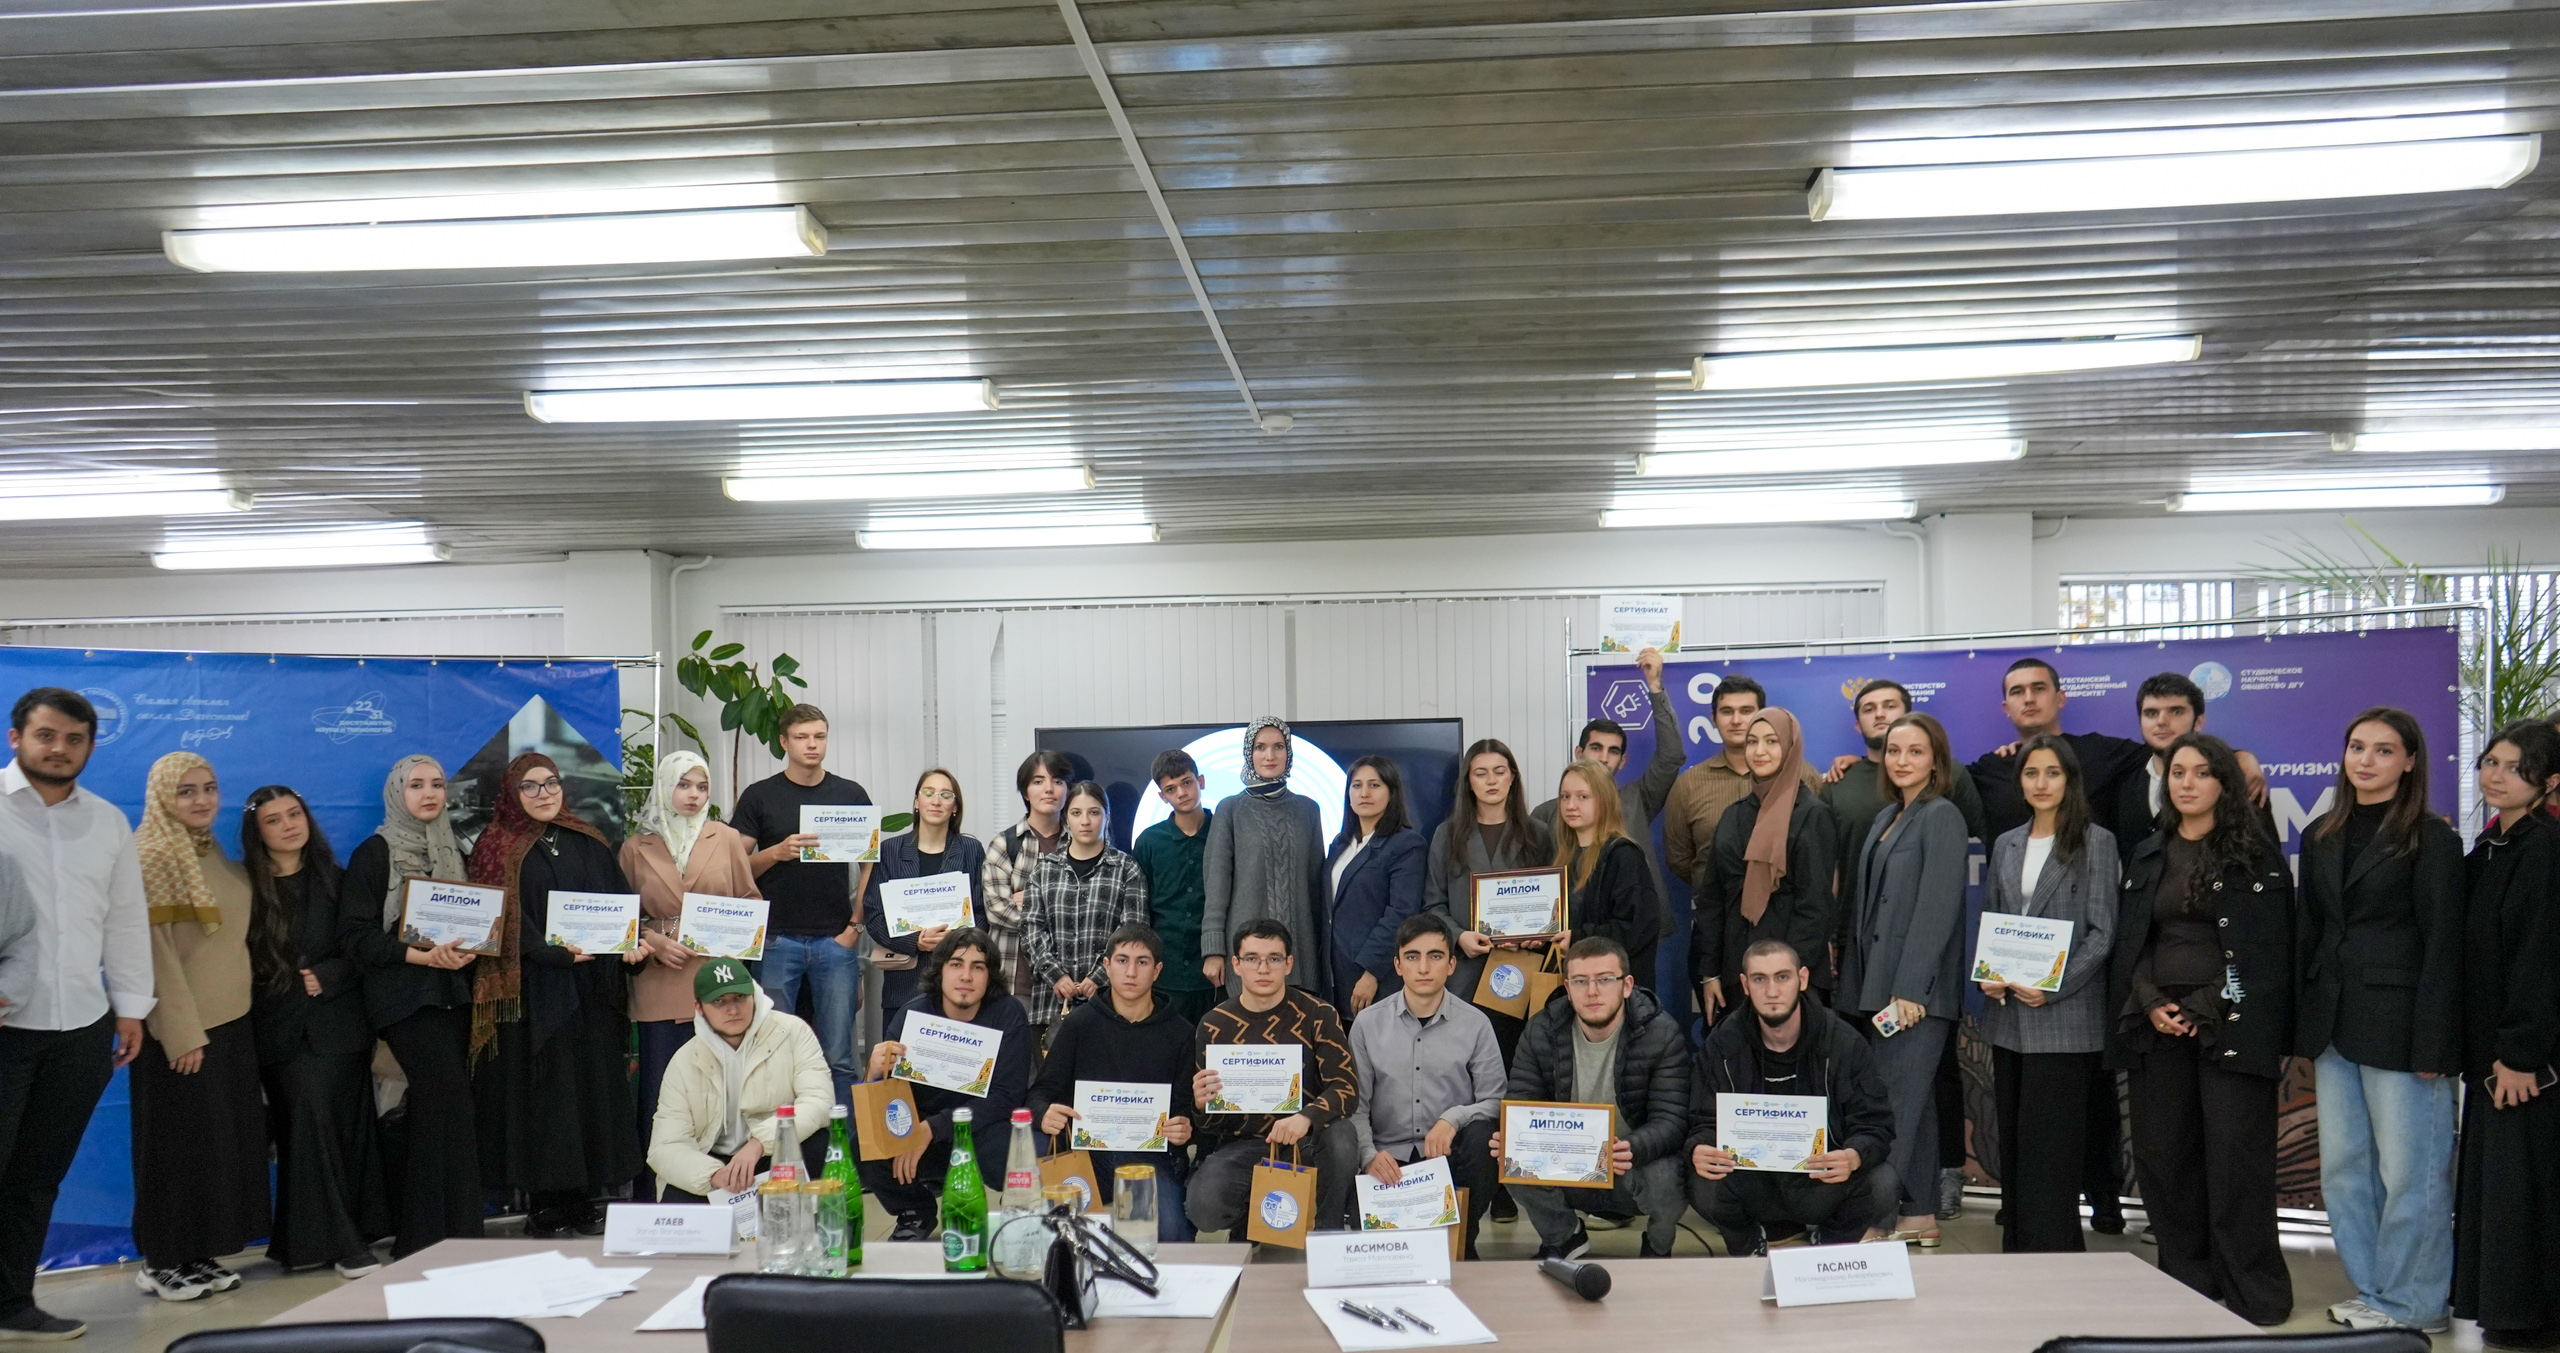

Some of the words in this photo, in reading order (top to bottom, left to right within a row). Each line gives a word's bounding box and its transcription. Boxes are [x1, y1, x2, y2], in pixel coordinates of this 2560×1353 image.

[1613, 606, 1669, 614] СЕРТИФИКАТ
[2240, 667, 2303, 676] СТУДЕНЧЕСКОЕ
[2059, 674, 2111, 684] АГЕСТАНСКИЙ
[2241, 675, 2279, 683] НАУЧНОЕ
[2060, 681, 2128, 691] СУДАРСТВЕННЫЙ
[2240, 682, 2287, 690] ОБЩЕСТВО
[2288, 681, 2305, 689] ДГУ
[2064, 690, 2107, 698] ИВЕРСИТЕТ
[355, 701, 373, 711] 22
[368, 710, 383, 720] 31
[903, 885, 957, 896] СЕРТИФИКАТ
[1496, 884, 1540, 896] ДИПЛОМ
[430, 892, 481, 907] ДИПЛОМ
[563, 903, 624, 913] СЕРТИФИКАТ
[696, 905, 754, 918] СЕРТИФИКАТ
[1994, 927, 2056, 941] СЕРТИФИКАТ
[713, 964, 735, 984] NY
[919, 1027, 984, 1048] СЕРТИФИКАТ
[1222, 1057, 1286, 1066] СЕРТИФИКАТ
[1090, 1094, 1154, 1104] СЕРТИФИКАТ
[1734, 1108, 1808, 1119] СЕРТИФИКАТ
[1529, 1119, 1584, 1130] ДИПЛОМ
[771, 1170, 794, 1178] MEVER
[1008, 1177, 1030, 1185] MEVER
[727, 1189, 759, 1206] СЕРТИ
[653, 1217, 685, 1227] АТАЕВ
[1345, 1241, 1409, 1254] КАСИМОВА
[1817, 1260, 1868, 1273] ГАСАНОВ
